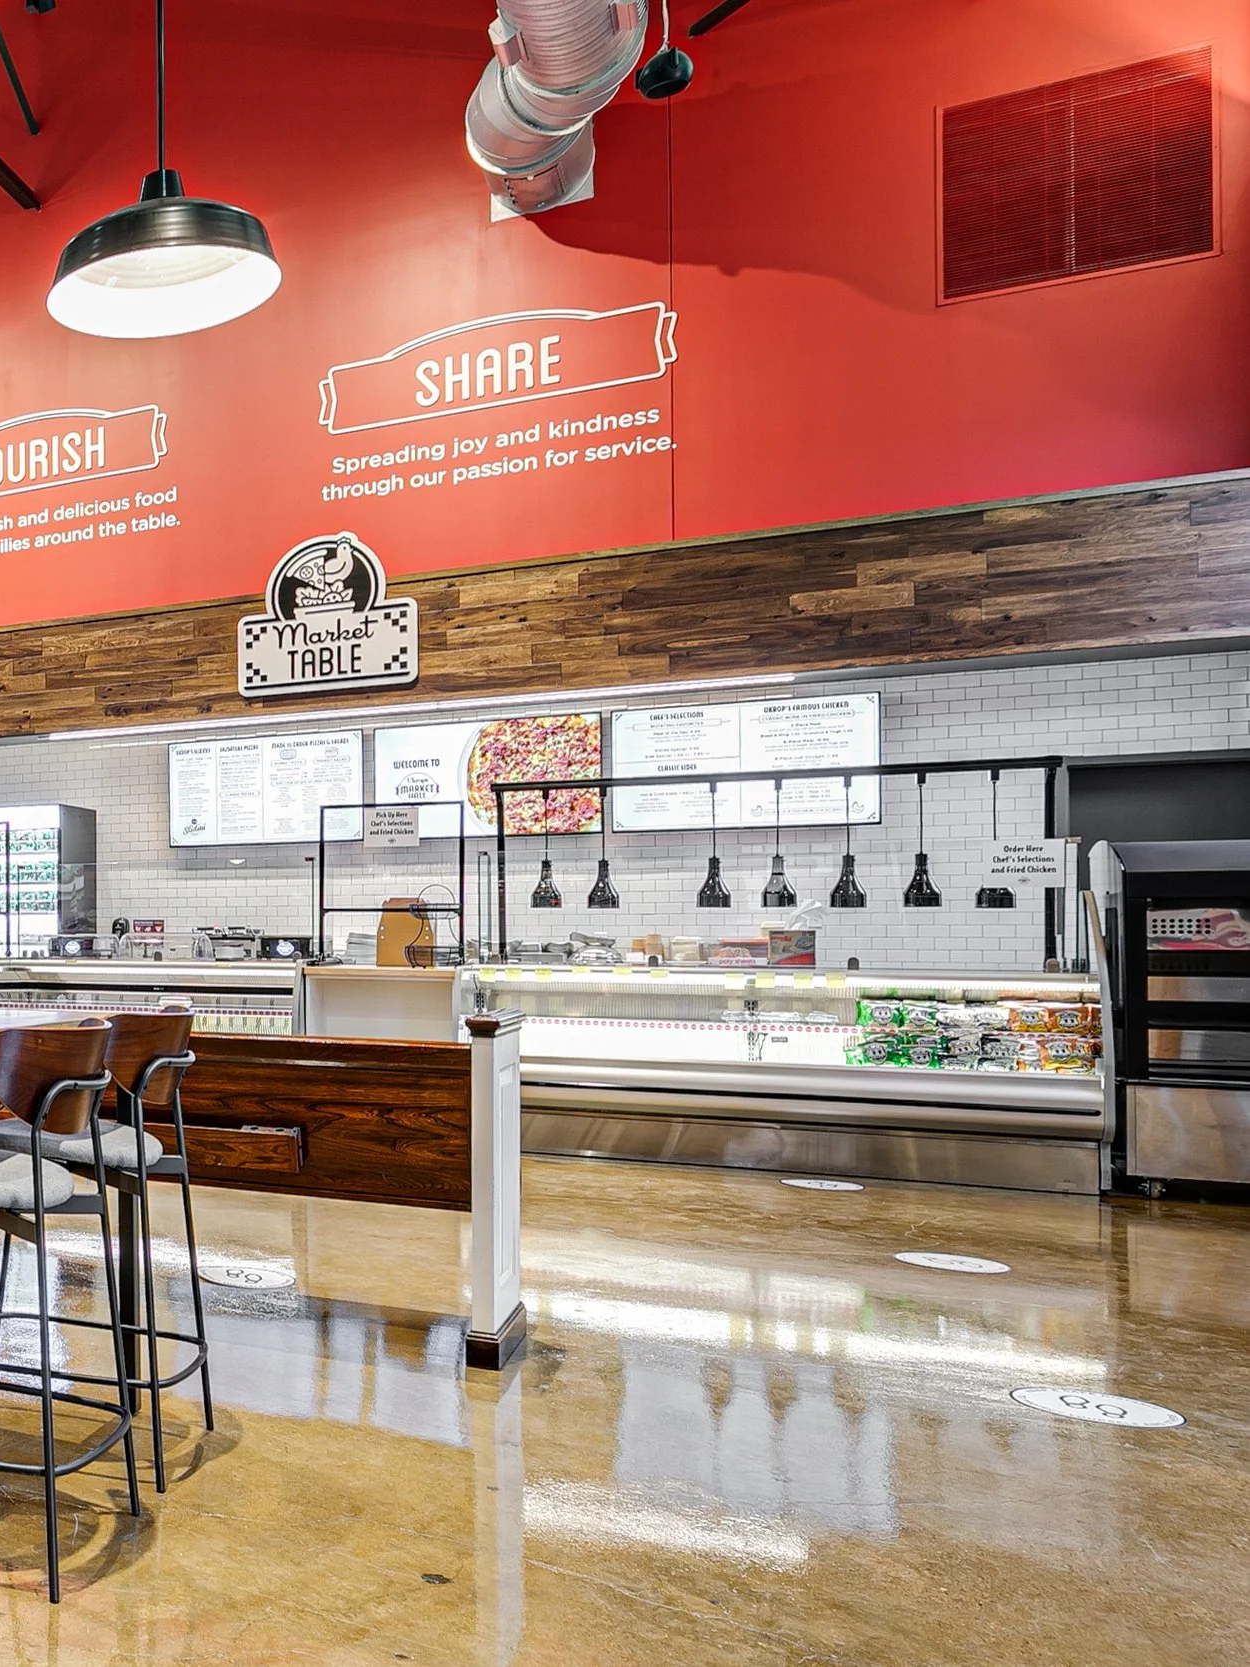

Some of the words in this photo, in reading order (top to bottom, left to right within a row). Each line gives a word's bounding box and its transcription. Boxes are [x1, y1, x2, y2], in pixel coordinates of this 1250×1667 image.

[415, 335, 562, 407] SHARE
[332, 442, 445, 476] Spreading
[451, 436, 488, 459] joy
[495, 424, 540, 449] and
[548, 407, 660, 439] kindness
[322, 474, 404, 502] through
[410, 469, 446, 490] our
[453, 455, 537, 485] passion
[545, 447, 579, 468] for
[584, 434, 678, 463] service.
[17, 508, 49, 528] and
[53, 497, 130, 521] delicious
[134, 486, 177, 507] food
[34, 526, 93, 548] around
[98, 520, 126, 539] the
[131, 512, 181, 533] table.
[272, 615, 379, 650] Market
[287, 644, 362, 679] TABLE
[764, 705, 791, 713] UKROP'S
[793, 703, 820, 711] FAMOUS
[822, 701, 849, 709] CHICKEN
[650, 713, 669, 721] CHEF'S
[670, 711, 704, 719] SELECTIONS
[393, 759, 429, 769] WELCOME
[431, 758, 440, 767] TO
[658, 764, 679, 772] CLASSIC
[400, 784, 434, 794] MARKET
[1003, 845, 1025, 853] Order
[992, 856, 1015, 864] Chef's
[1017, 855, 1055, 863] Selections
[1006, 865, 1025, 873] Fried
[1027, 865, 1057, 873] Chicken
